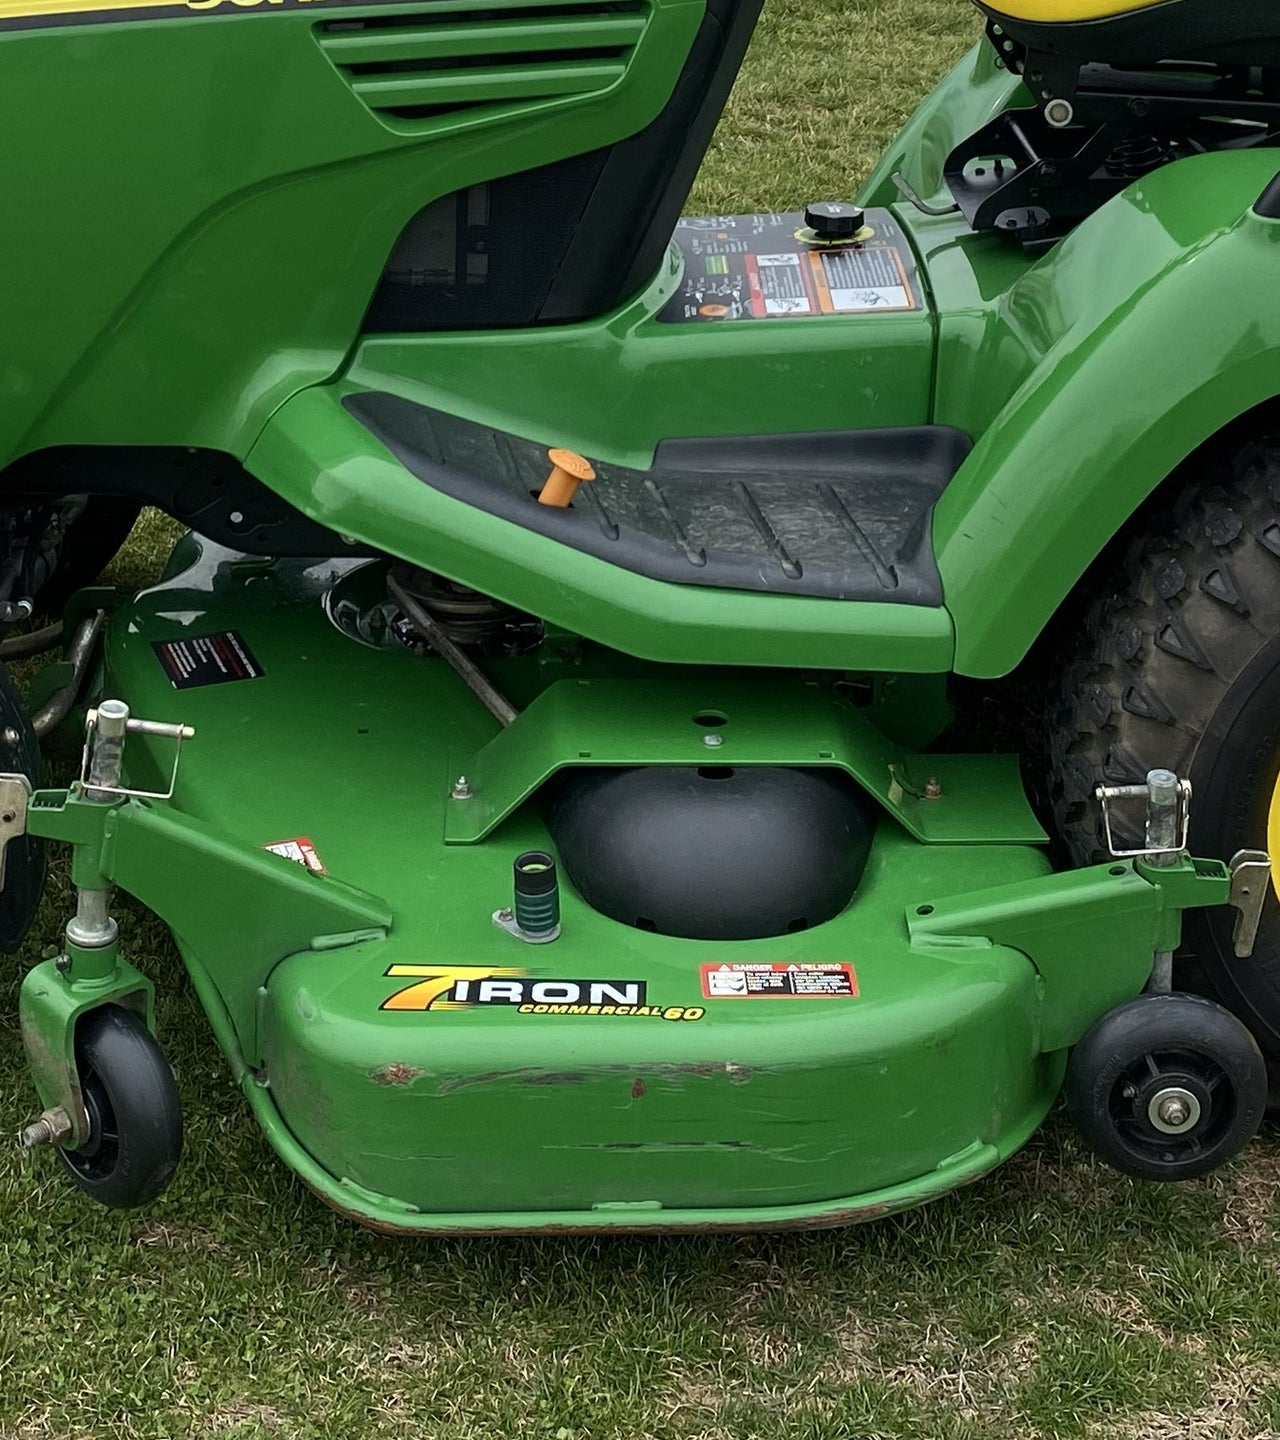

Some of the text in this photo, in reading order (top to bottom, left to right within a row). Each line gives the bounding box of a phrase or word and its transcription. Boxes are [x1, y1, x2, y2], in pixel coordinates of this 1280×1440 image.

[731, 963, 842, 972] DANGER PELIGRO
[517, 1002, 706, 1021] COMMERCIAL 60
